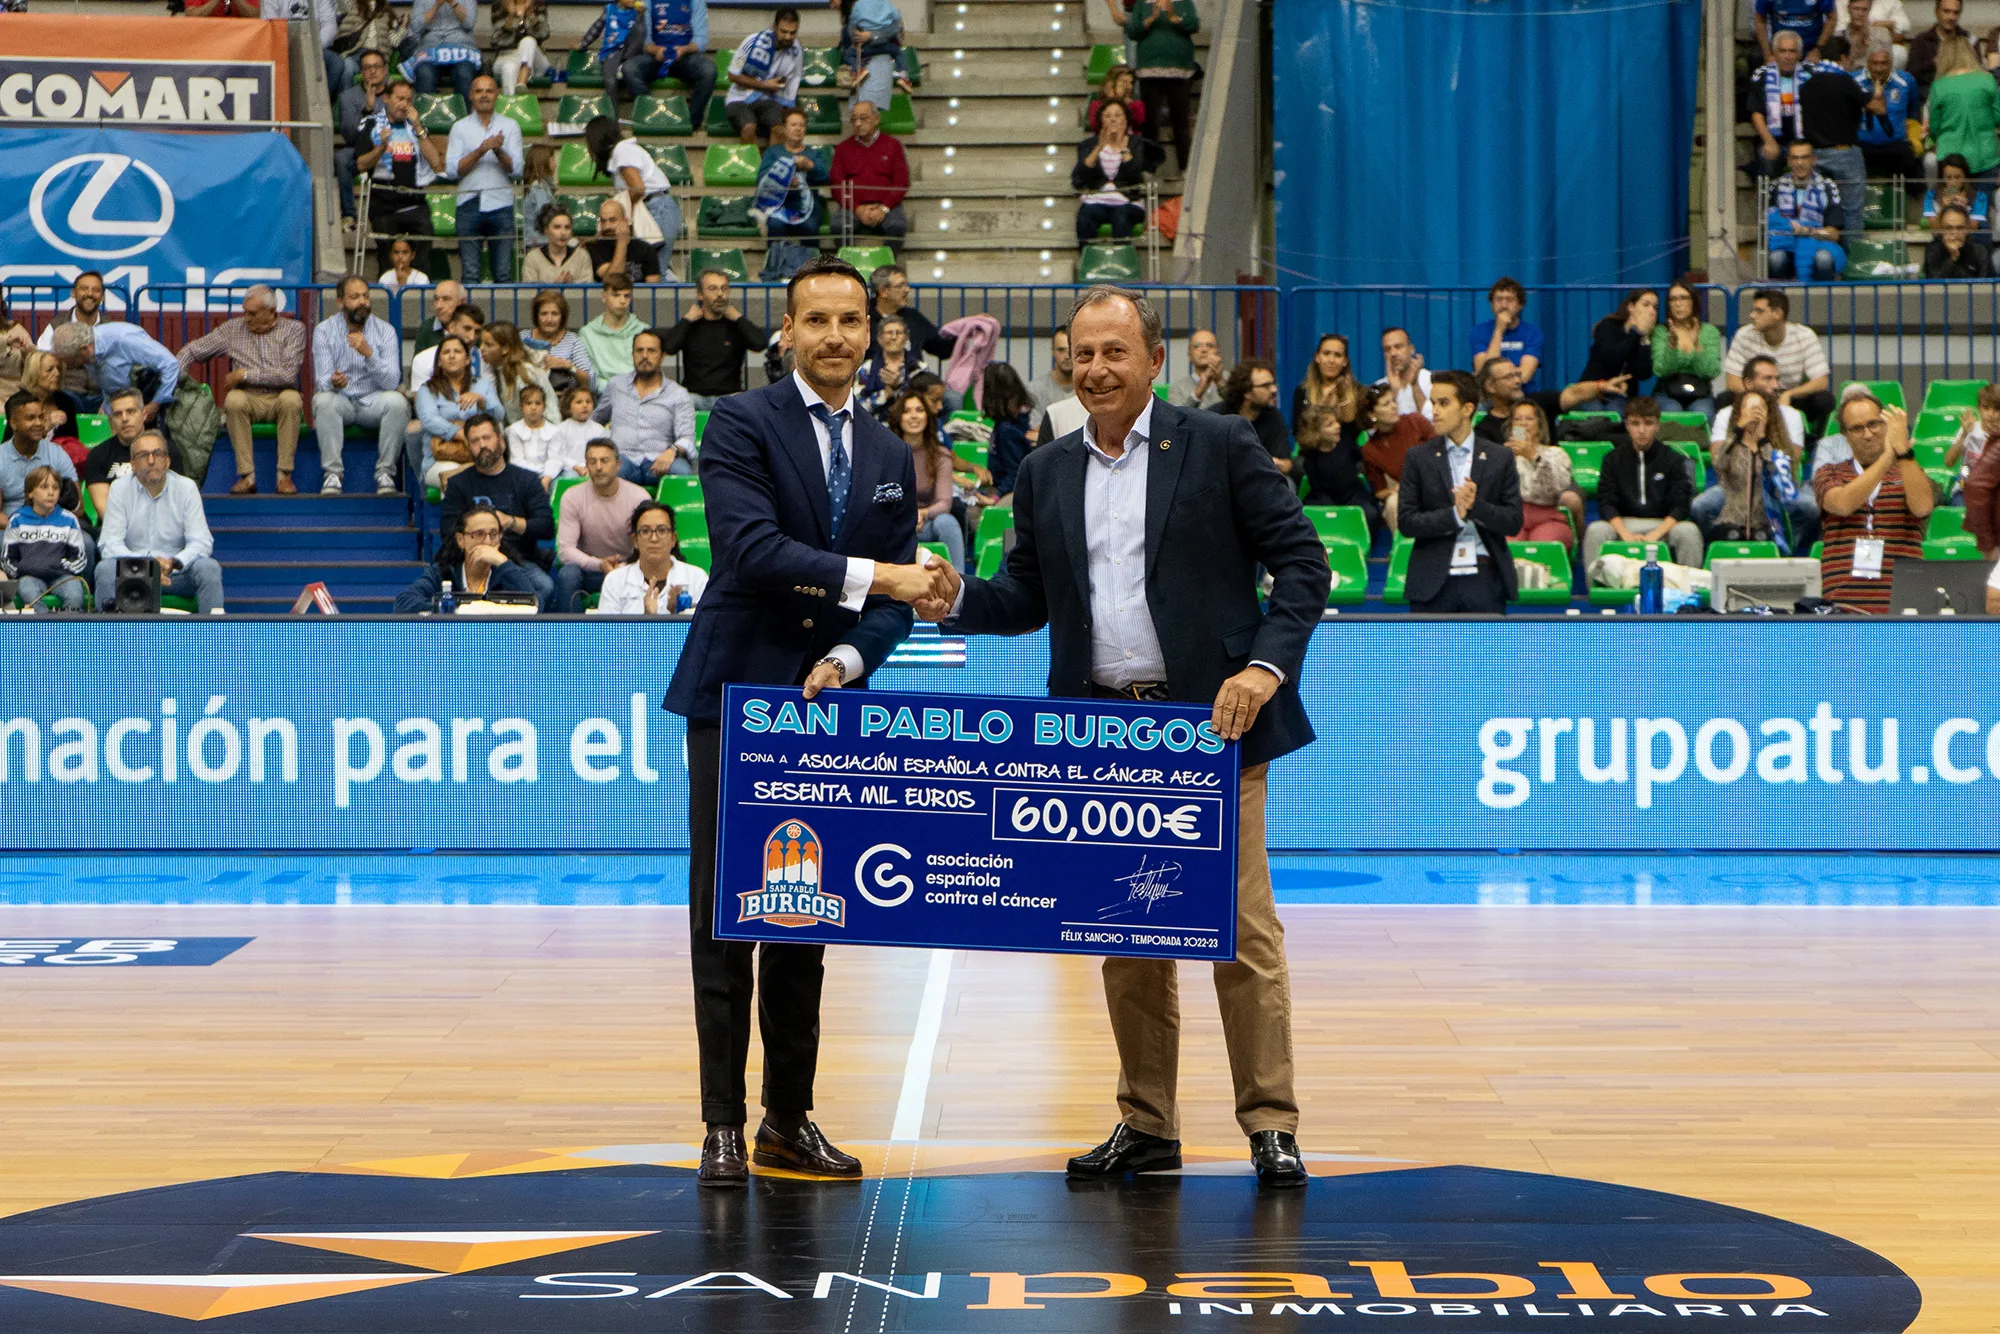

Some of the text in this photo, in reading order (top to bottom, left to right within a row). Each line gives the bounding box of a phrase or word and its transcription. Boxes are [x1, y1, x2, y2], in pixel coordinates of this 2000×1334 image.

[0, 72, 259, 121] COMART
[19, 529, 67, 541] adidas
[741, 698, 1226, 755] SAN PABLO BURGOS
[333, 717, 539, 808] para
[570, 692, 659, 783] el
[1477, 701, 2000, 809] grupoatu.c
[740, 752, 1221, 787] DONA A ASOCIACIÓN ESPAÑOLA CONTRA EL CÁNCER AECC
[753, 781, 976, 809] SESENTA MIL EUROS
[1011, 796, 1202, 842] 60,000€
[925, 852, 1014, 869] asociación
[769, 884, 815, 895] SAN PABLO
[925, 872, 1001, 888] española
[746, 893, 840, 920] BURGOS
[925, 890, 1058, 909] contra el cáncer
[1061, 929, 1219, 949] FÉLIX SANCHO TEMPORADA 2022-23
[1168, 1302, 1830, 1317] INMOBILIARIA
